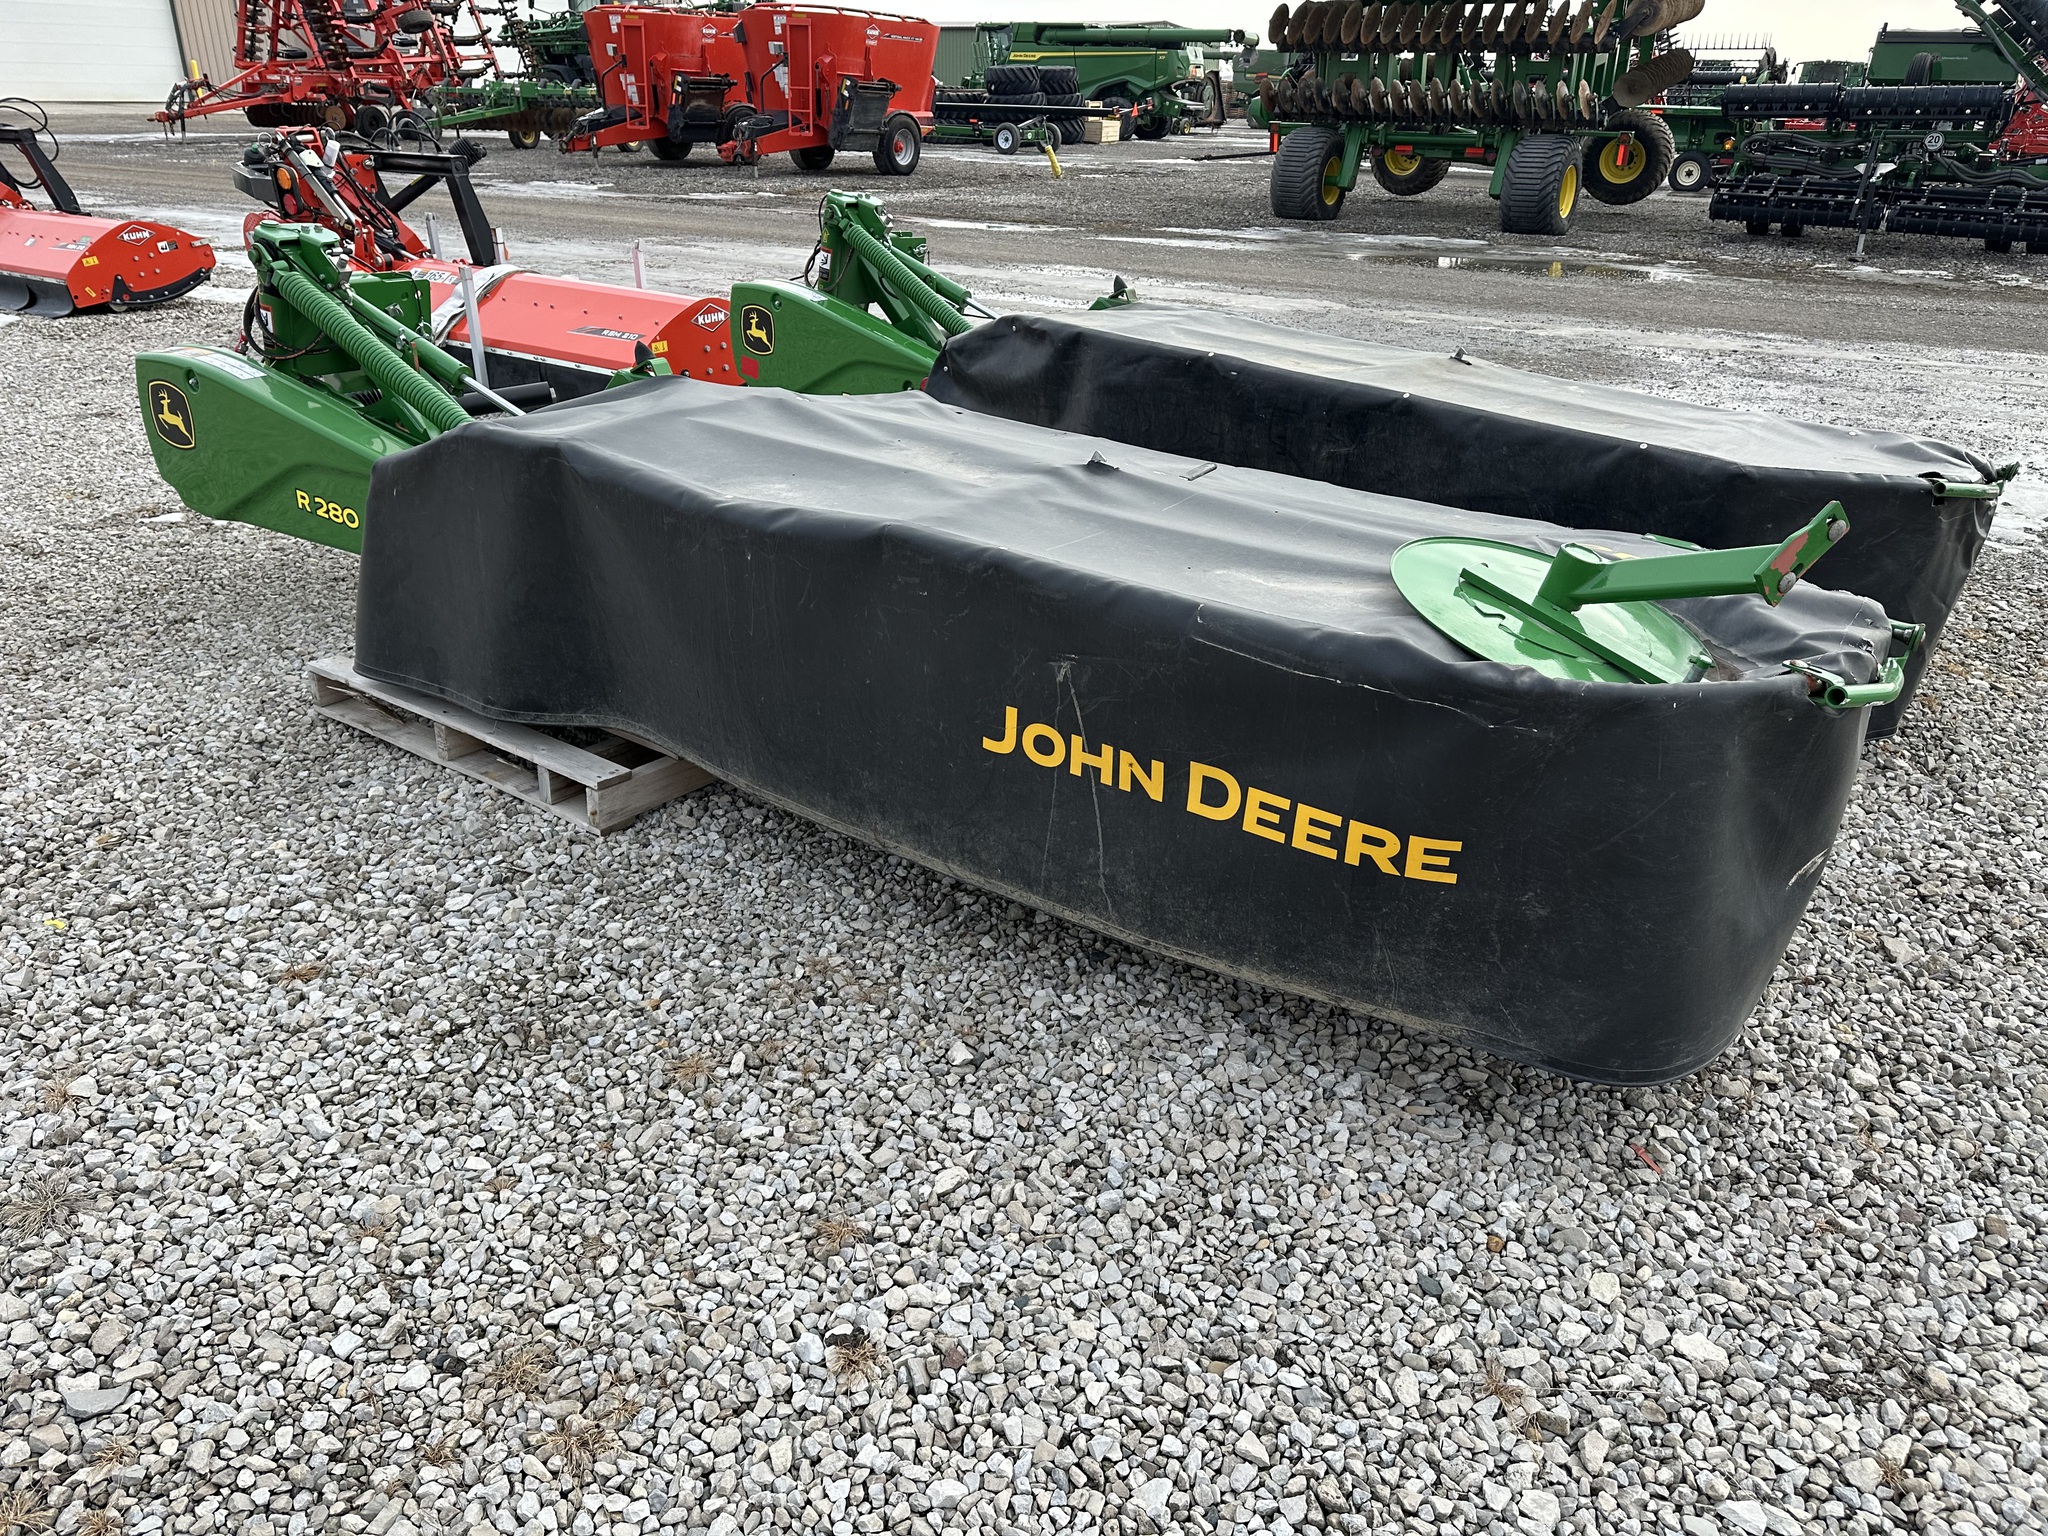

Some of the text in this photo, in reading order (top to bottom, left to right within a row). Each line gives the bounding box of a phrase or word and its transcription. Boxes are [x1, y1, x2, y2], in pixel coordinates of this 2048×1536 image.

[1927, 135, 1941, 144] 20
[123, 230, 150, 241] KUHN
[697, 311, 726, 325] KUHN
[621, 332, 639, 341] 210
[295, 488, 360, 530] R 280
[982, 705, 1463, 885] JOHN DEERE
